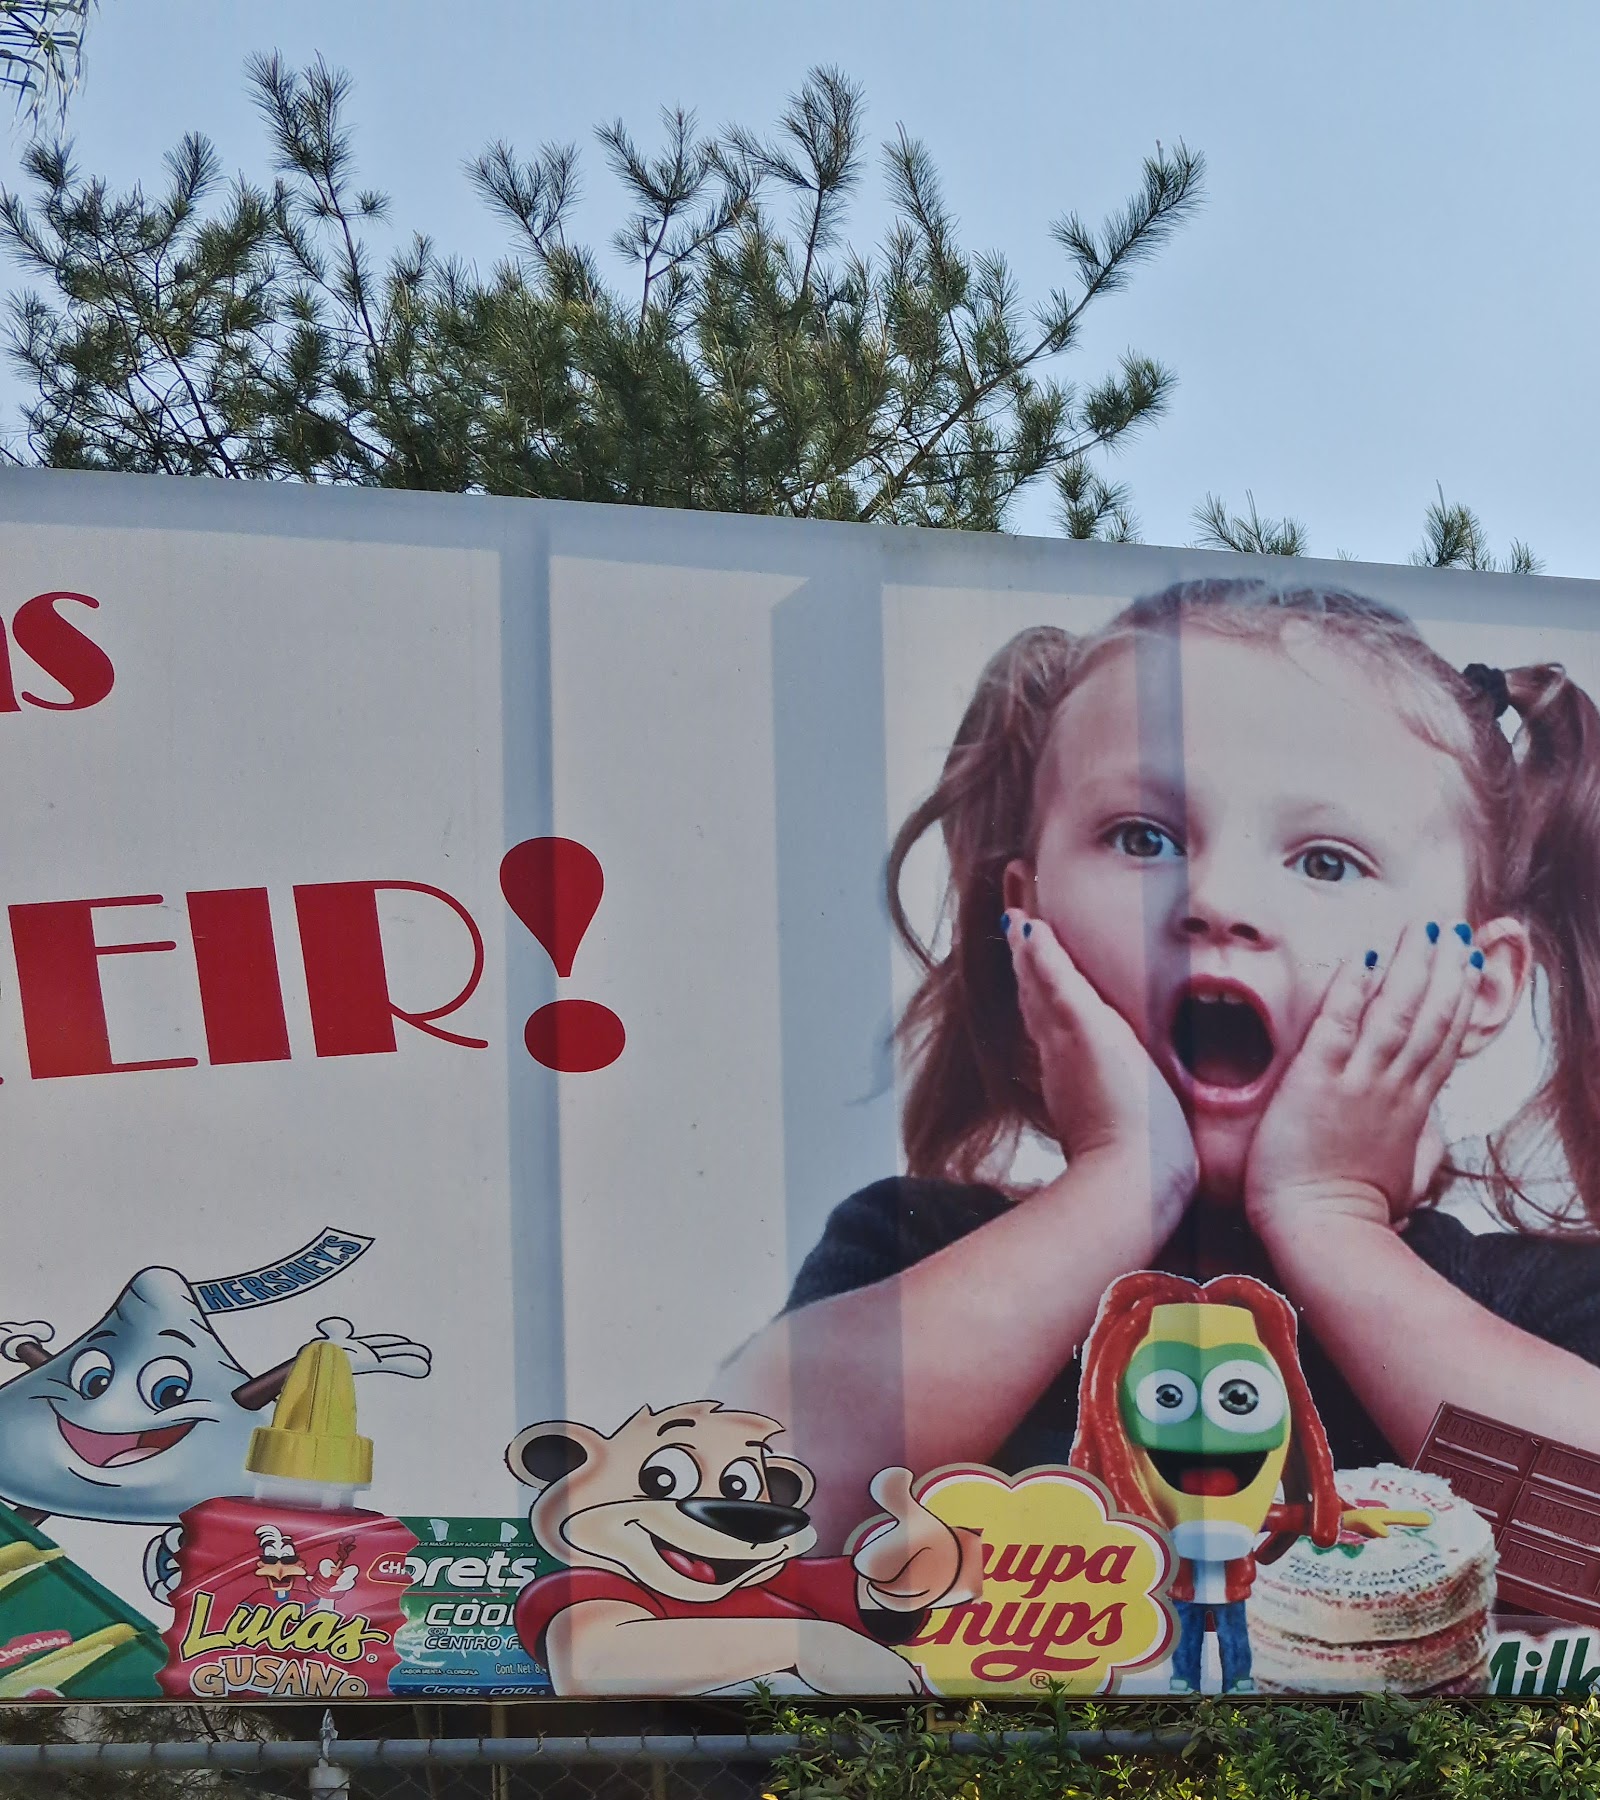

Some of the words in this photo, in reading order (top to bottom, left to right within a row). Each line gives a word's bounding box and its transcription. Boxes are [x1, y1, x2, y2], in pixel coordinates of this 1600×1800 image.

[0, 592, 114, 713] s
[0, 836, 625, 1085] EIR!
[198, 1235, 361, 1310] HERSHEY'S
[404, 1550, 538, 1588] orets
[182, 1590, 390, 1661] Lucas
[424, 1636, 503, 1651] CENTRO
[192, 1655, 368, 1697] GUSANO
[422, 1686, 480, 1696] Clorets
